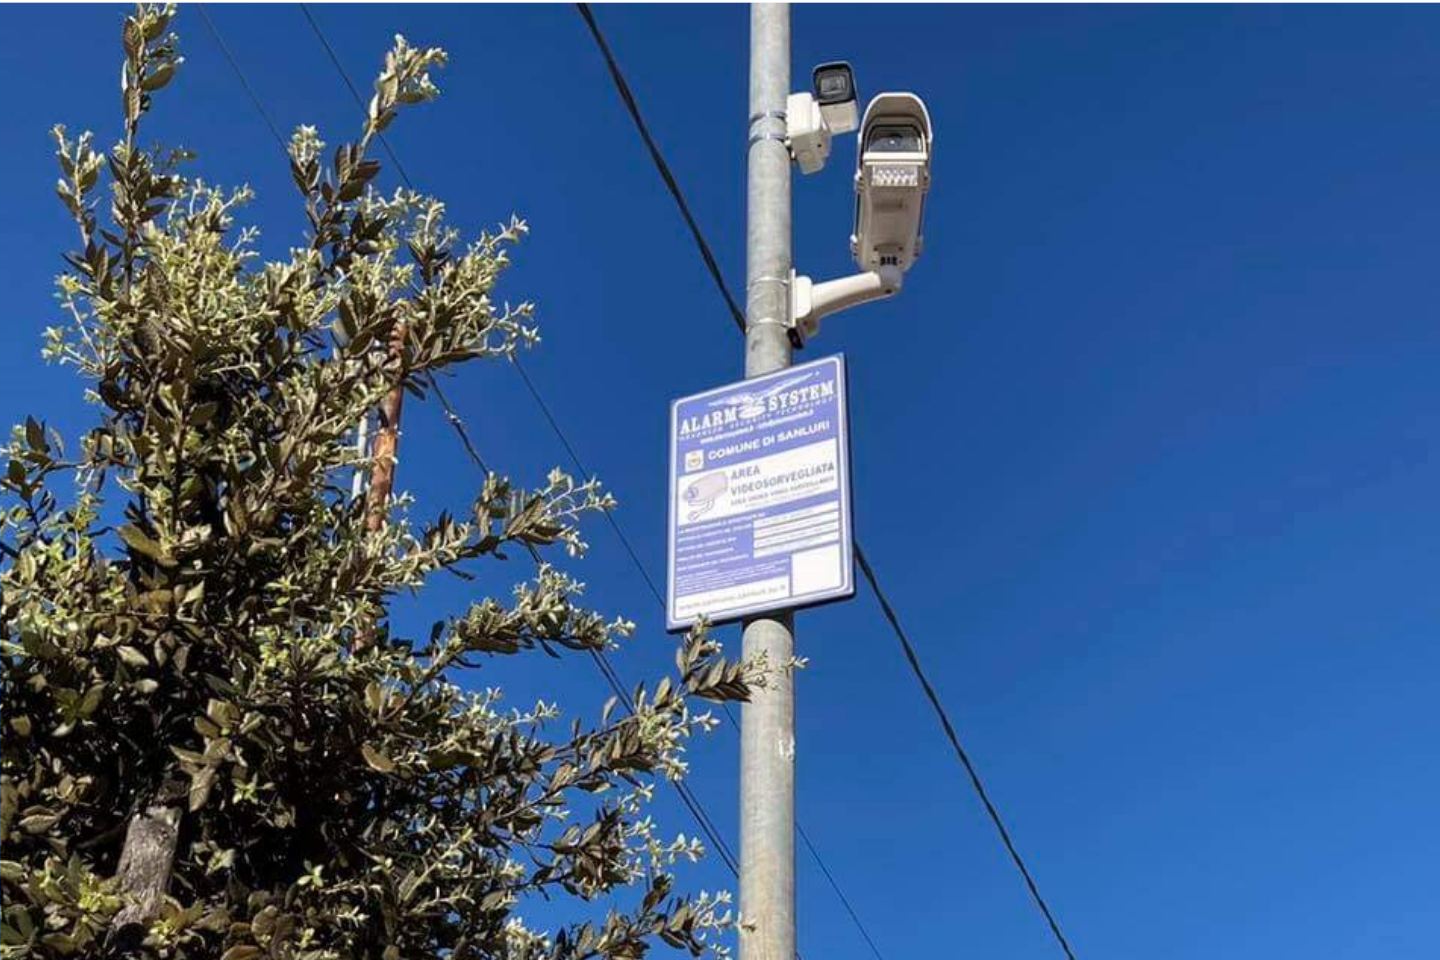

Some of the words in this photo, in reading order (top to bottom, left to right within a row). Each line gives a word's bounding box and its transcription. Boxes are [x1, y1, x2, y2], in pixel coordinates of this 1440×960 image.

[680, 406, 737, 435] ALARM
[768, 380, 834, 411] SYSTEM
[708, 438, 760, 460] COMUNE
[762, 435, 776, 446] DI
[777, 420, 830, 442] SANLURI
[730, 464, 760, 480] AREA
[730, 462, 834, 496] VIDEOSORVEGLIATA
